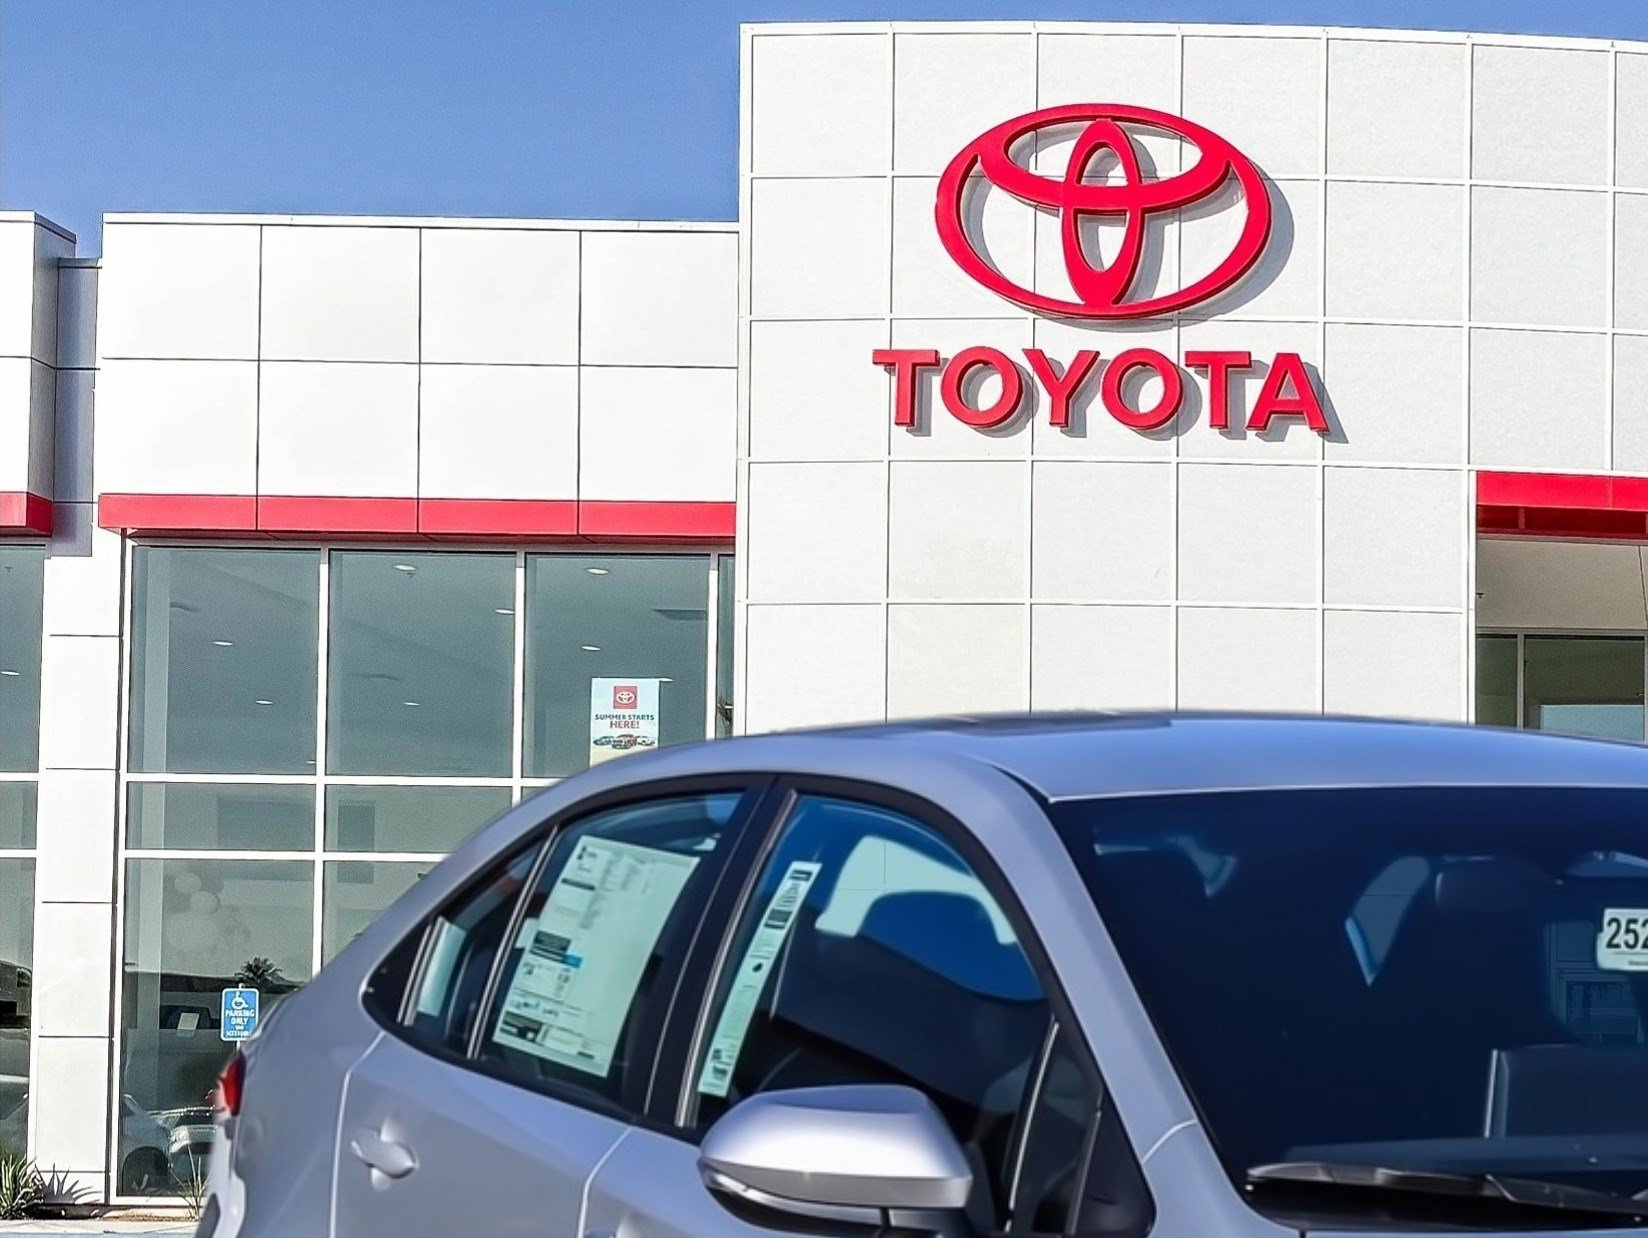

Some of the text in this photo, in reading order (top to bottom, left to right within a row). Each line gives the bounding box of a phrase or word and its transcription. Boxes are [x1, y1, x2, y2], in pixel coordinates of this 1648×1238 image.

[872, 346, 1328, 431] TOYOTA
[609, 720, 640, 729] HERE!
[225, 1009, 255, 1017] PARKING
[231, 1017, 249, 1025] ONLY
